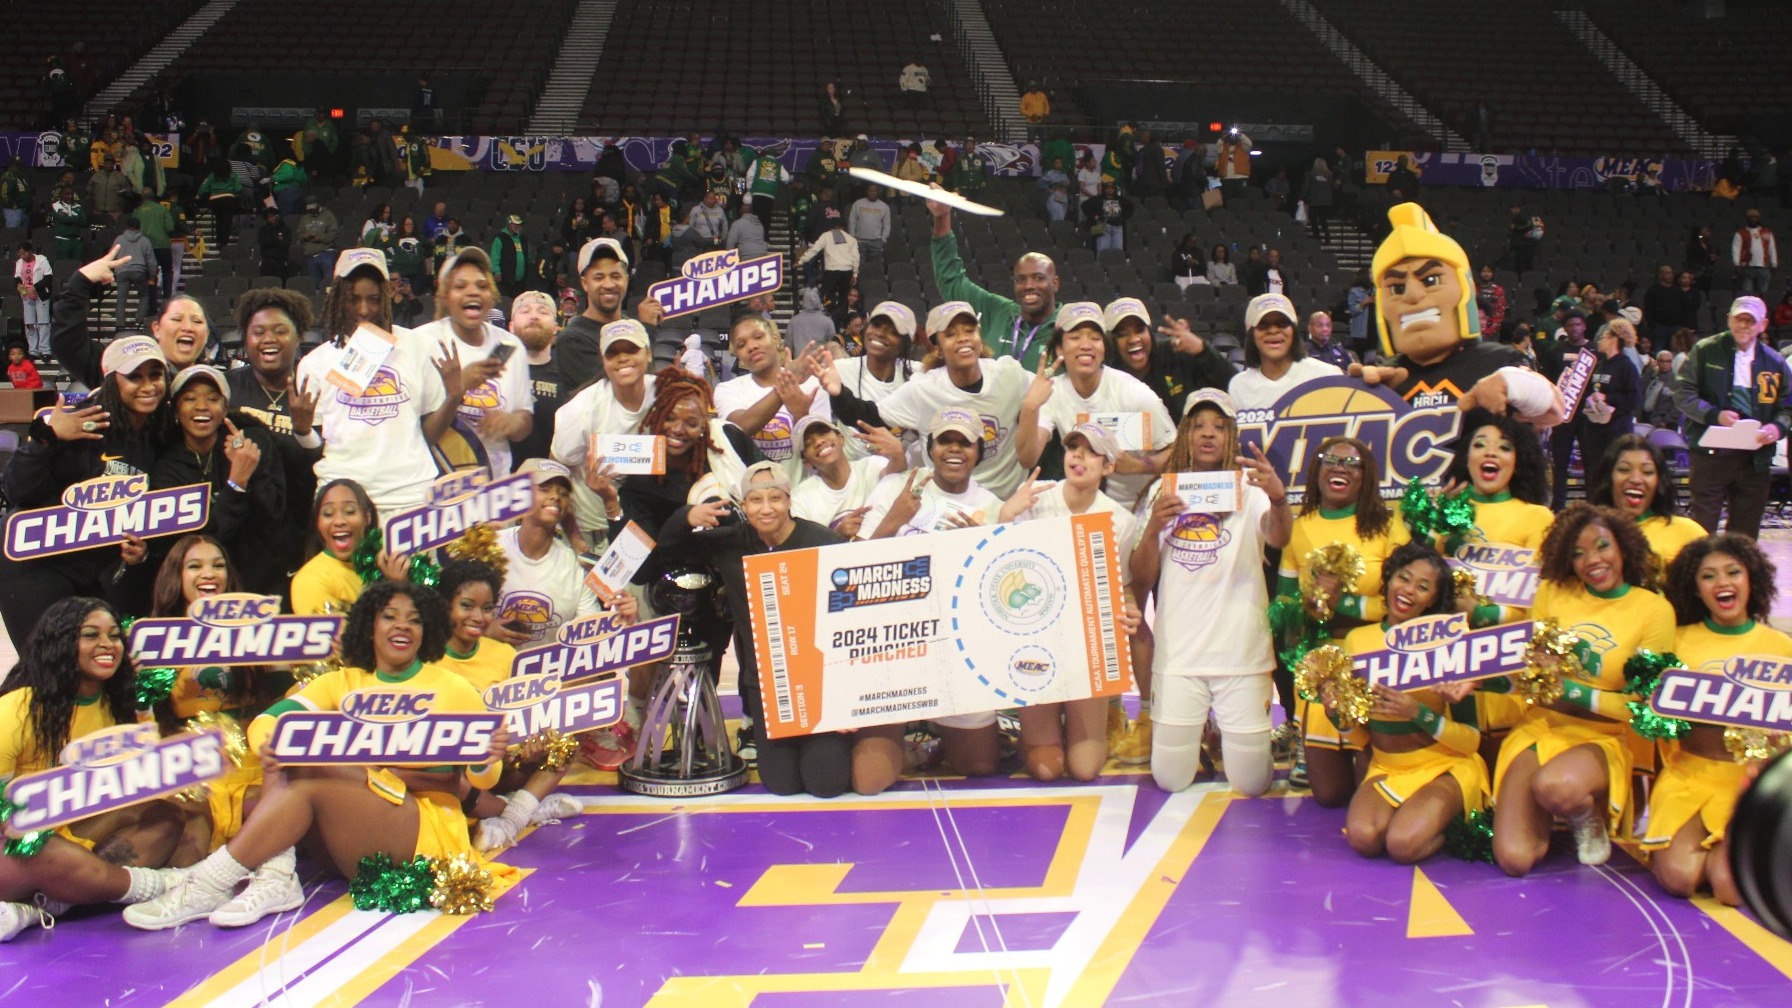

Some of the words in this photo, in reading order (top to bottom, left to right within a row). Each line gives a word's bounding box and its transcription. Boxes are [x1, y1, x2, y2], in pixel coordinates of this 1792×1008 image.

[690, 251, 737, 278] MEAC
[654, 260, 777, 313] CHAMPS
[350, 404, 398, 417] BASKETBALL
[1237, 410, 1276, 423] 2024
[1237, 405, 1466, 492] MEAC
[74, 476, 145, 507] MEAC
[14, 492, 202, 552] CHAMPS
[390, 479, 532, 554] CHAMPS
[1075, 523, 1089, 567] QUALIFIER
[1464, 545, 1534, 567] MEAC
[778, 562, 787, 573] 24
[849, 563, 903, 586] MARCH
[780, 573, 790, 595] SEAT
[857, 576, 931, 601] MADNESS
[1082, 568, 1094, 615] AUTOMATIC
[201, 598, 277, 621] MEAC
[131, 621, 335, 660] CHAMPS
[565, 614, 623, 643] MEAC
[787, 626, 795, 635] 17
[832, 628, 878, 649] 2024
[883, 619, 940, 642] TICKET
[1088, 615, 1101, 668] TOURNAMENT
[1394, 615, 1465, 649] MEAC
[517, 623, 671, 677] CHAMPS
[789, 636, 798, 656] ROW
[849, 640, 928, 666] PUNCHED
[1017, 660, 1050, 672] MEAC
[1094, 670, 1103, 691] NCAA
[348, 693, 436, 716] MEAC
[490, 675, 560, 708] MEAC
[859, 687, 928, 702] #MARCHMADNESS
[1657, 675, 1792, 723] CHAM
[796, 692, 808, 728] SECTION
[851, 699, 939, 717] @MARCHMADNESSWBB
[275, 720, 495, 756] CHAMPS
[13, 735, 222, 828] CHAMPS
